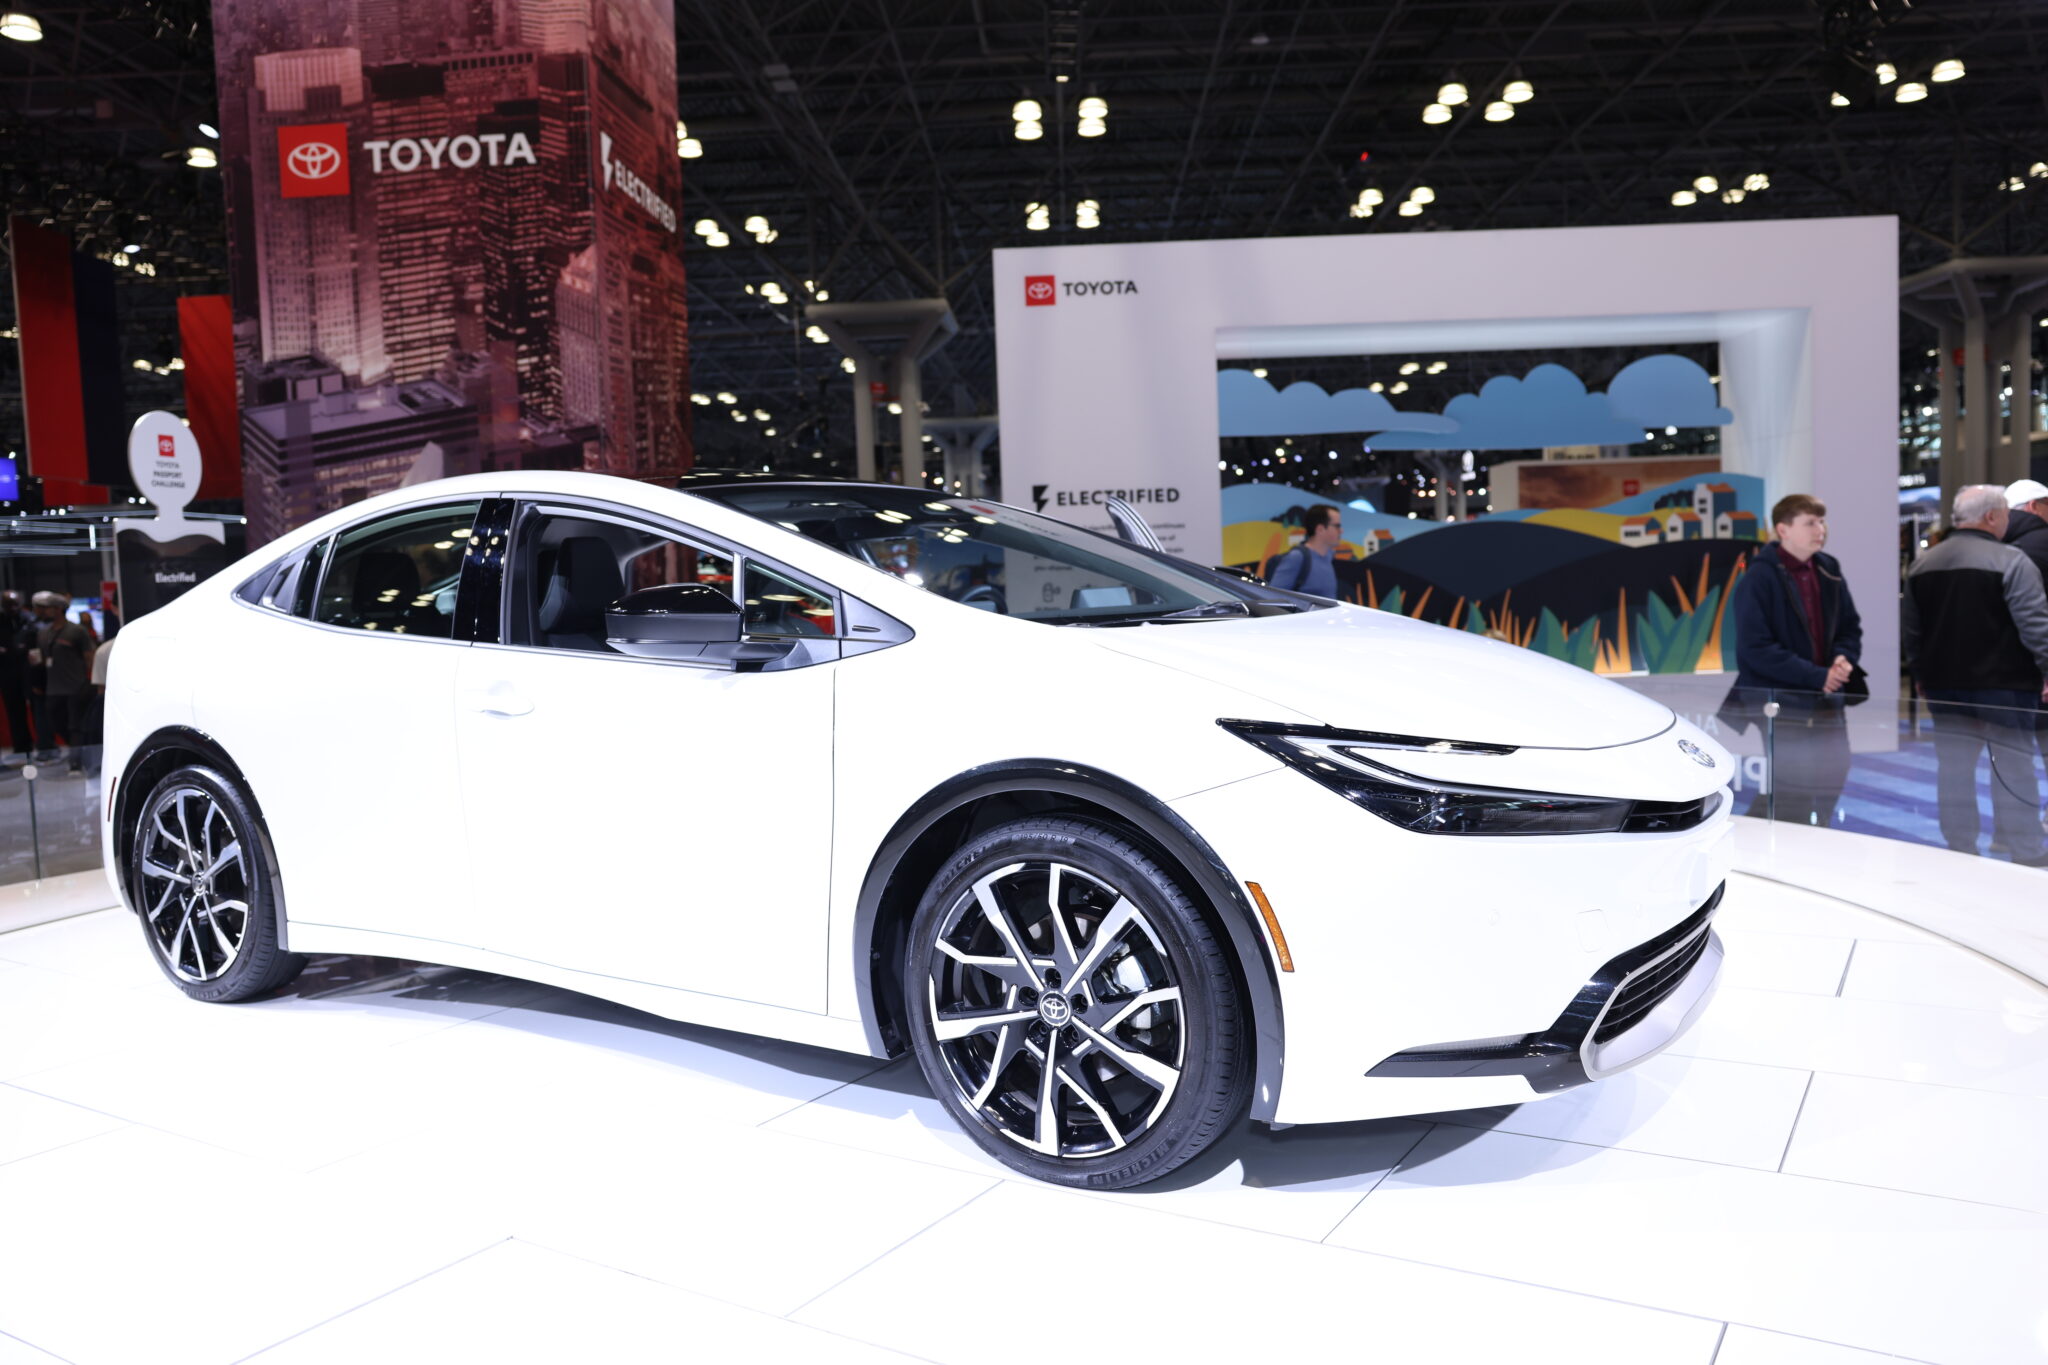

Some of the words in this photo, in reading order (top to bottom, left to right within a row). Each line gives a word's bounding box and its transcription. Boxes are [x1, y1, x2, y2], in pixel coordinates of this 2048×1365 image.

[363, 132, 537, 173] TOYOTA
[615, 159, 676, 233] ELECTRIFIED
[1062, 280, 1138, 296] TOYOTA
[156, 461, 180, 469] TOYOTA
[153, 471, 182, 479] PASSPORT
[151, 480, 185, 488] CHALLENGE
[1056, 488, 1180, 506] ELECTRIFIED
[155, 572, 196, 583] Electrified
[1092, 1142, 1171, 1185] MICHELIN
